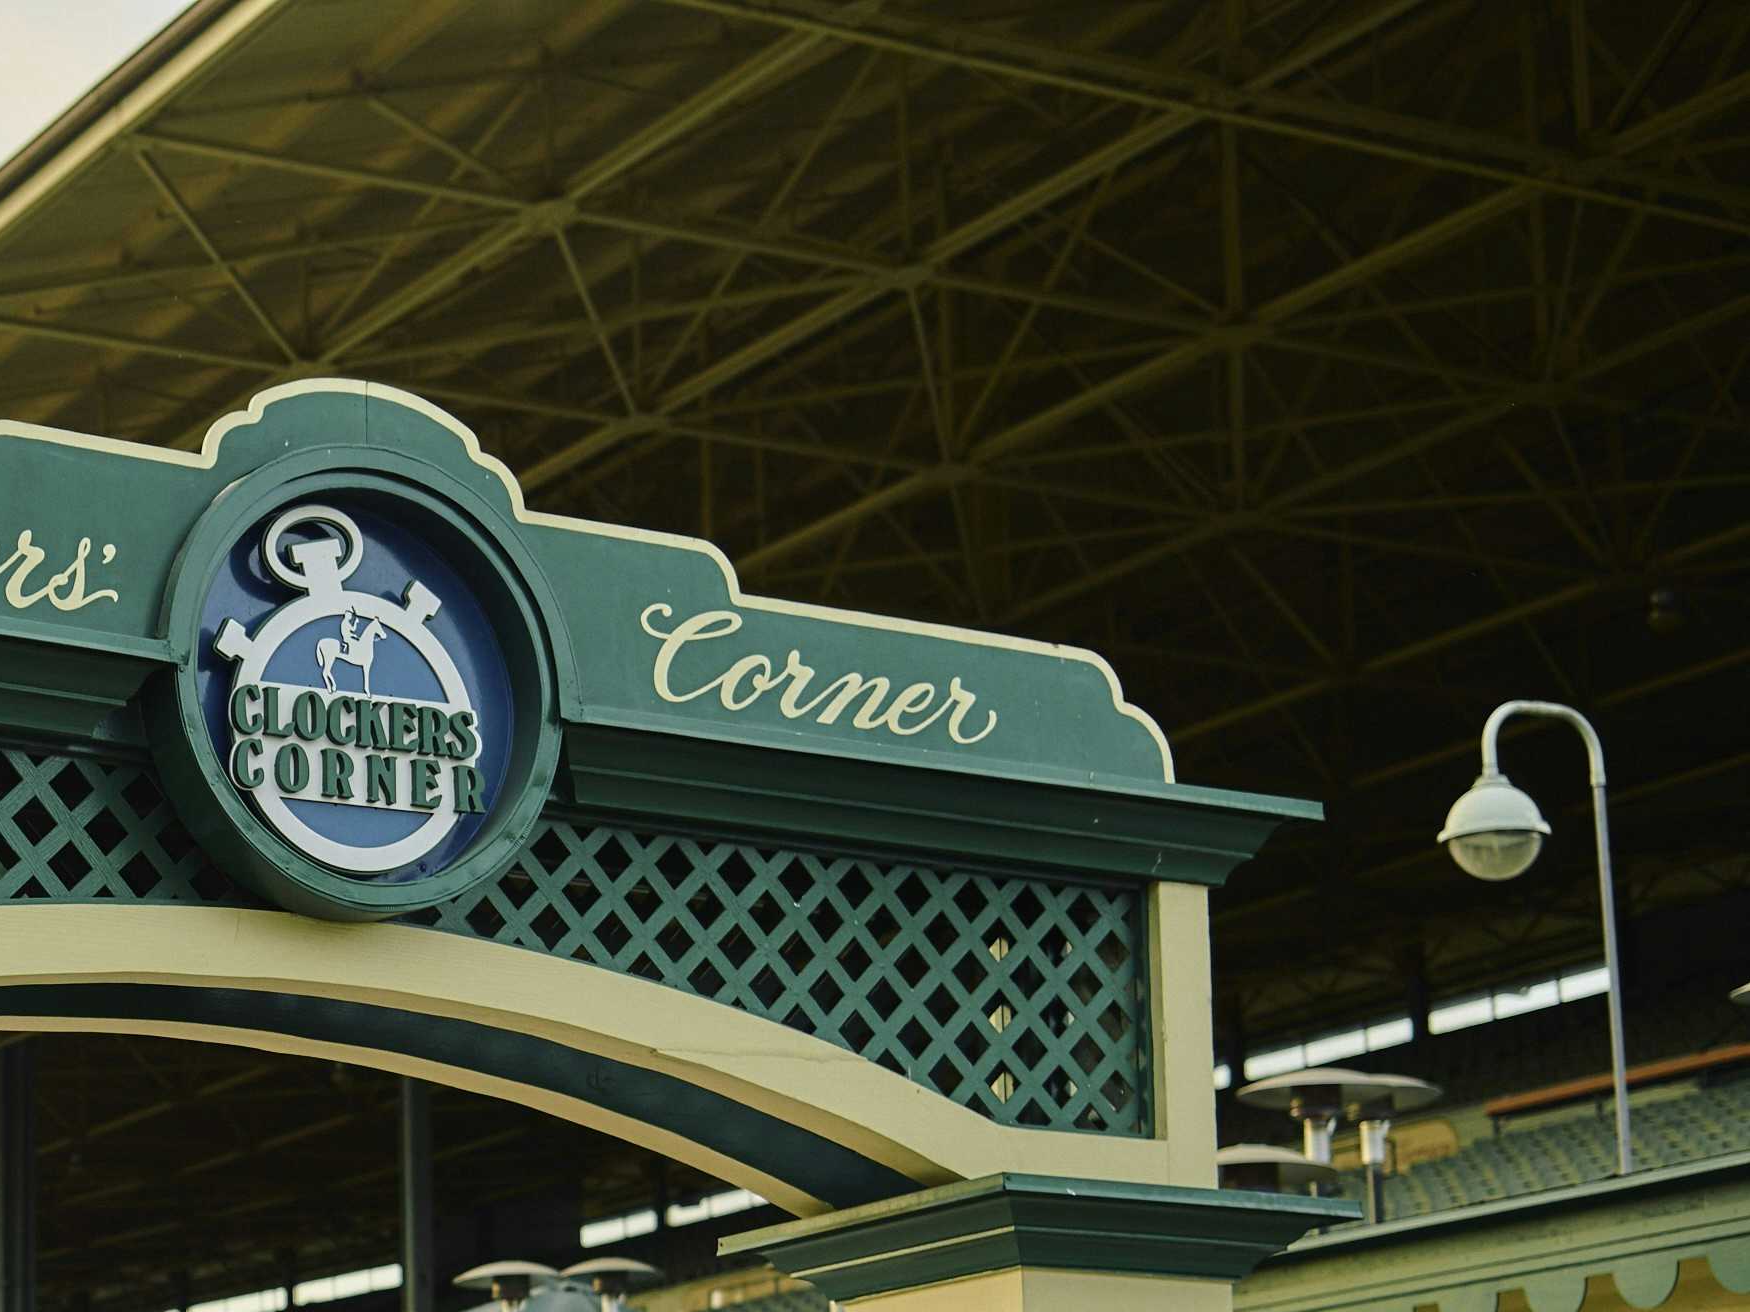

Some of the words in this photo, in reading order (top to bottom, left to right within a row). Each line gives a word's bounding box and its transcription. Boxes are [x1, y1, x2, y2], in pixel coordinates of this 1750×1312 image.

[640, 603, 997, 744] Corner
[230, 684, 479, 760] CLOCKERS
[231, 738, 485, 814] CORNER
